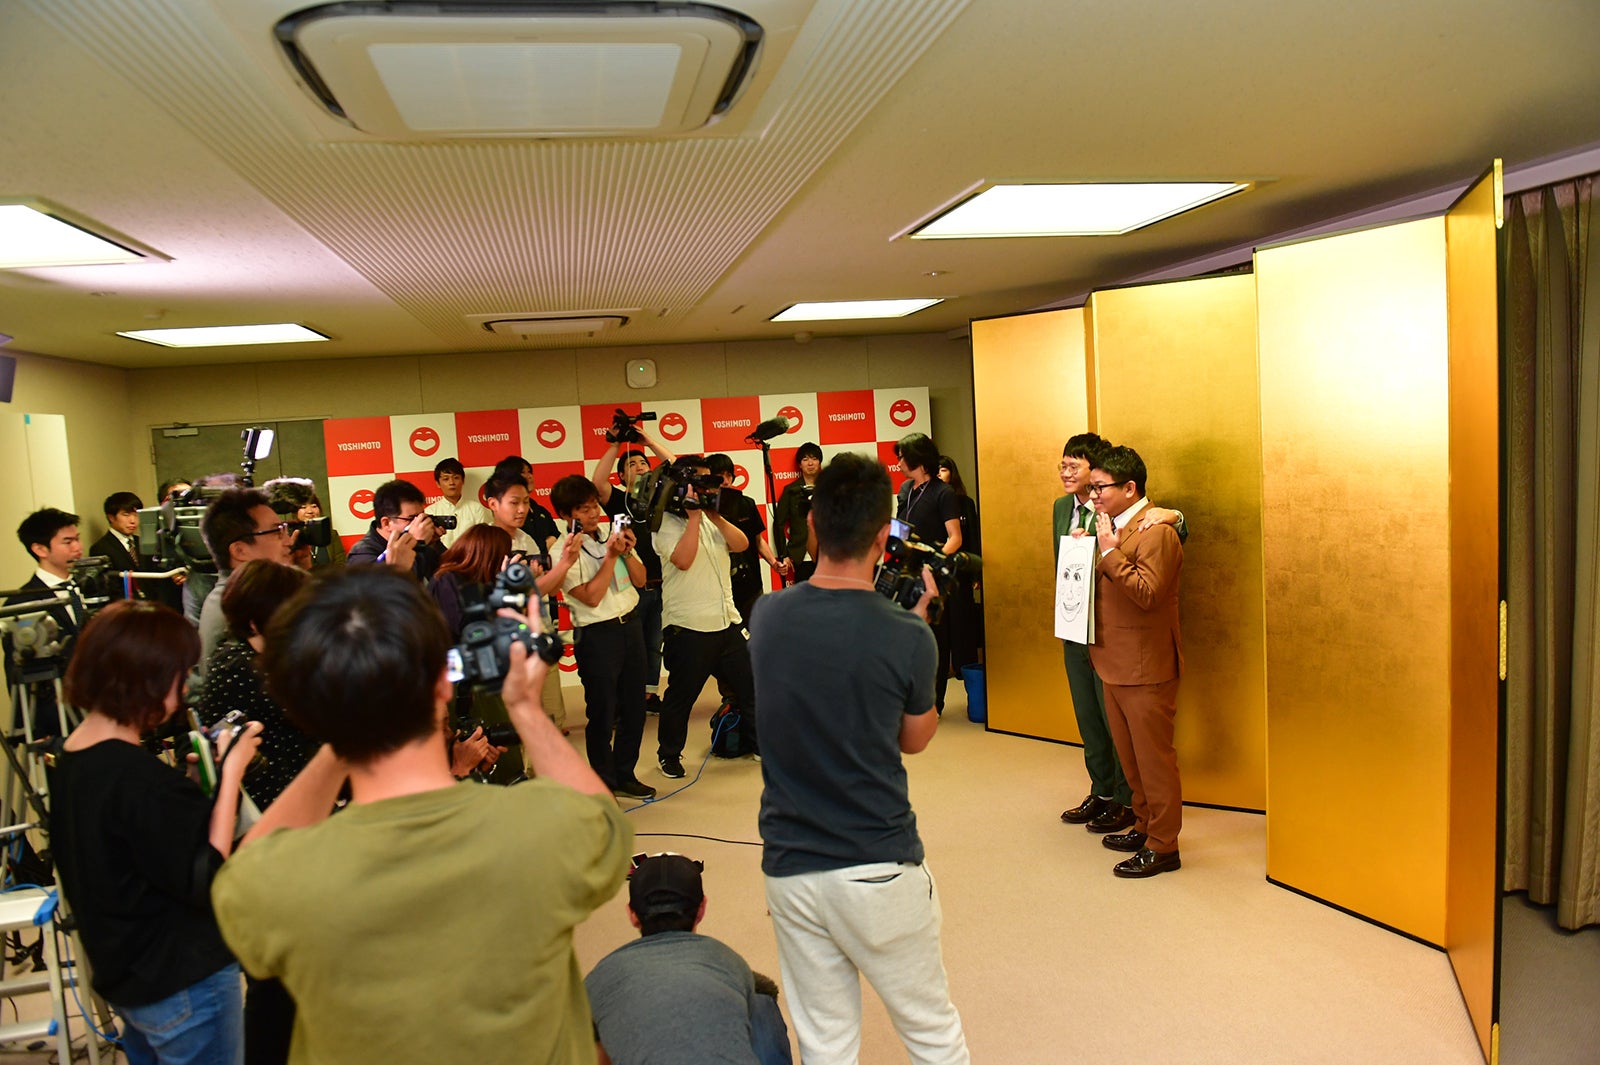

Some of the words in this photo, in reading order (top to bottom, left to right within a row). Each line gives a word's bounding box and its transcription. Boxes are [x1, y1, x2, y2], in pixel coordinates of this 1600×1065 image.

[828, 412, 866, 422] YOSHIMOTO
[712, 419, 751, 429] YOSHIMOTO
[592, 426, 609, 436] YOS
[467, 433, 510, 443] YOSHIMOTO
[337, 441, 381, 451] YOSHIMOTO
